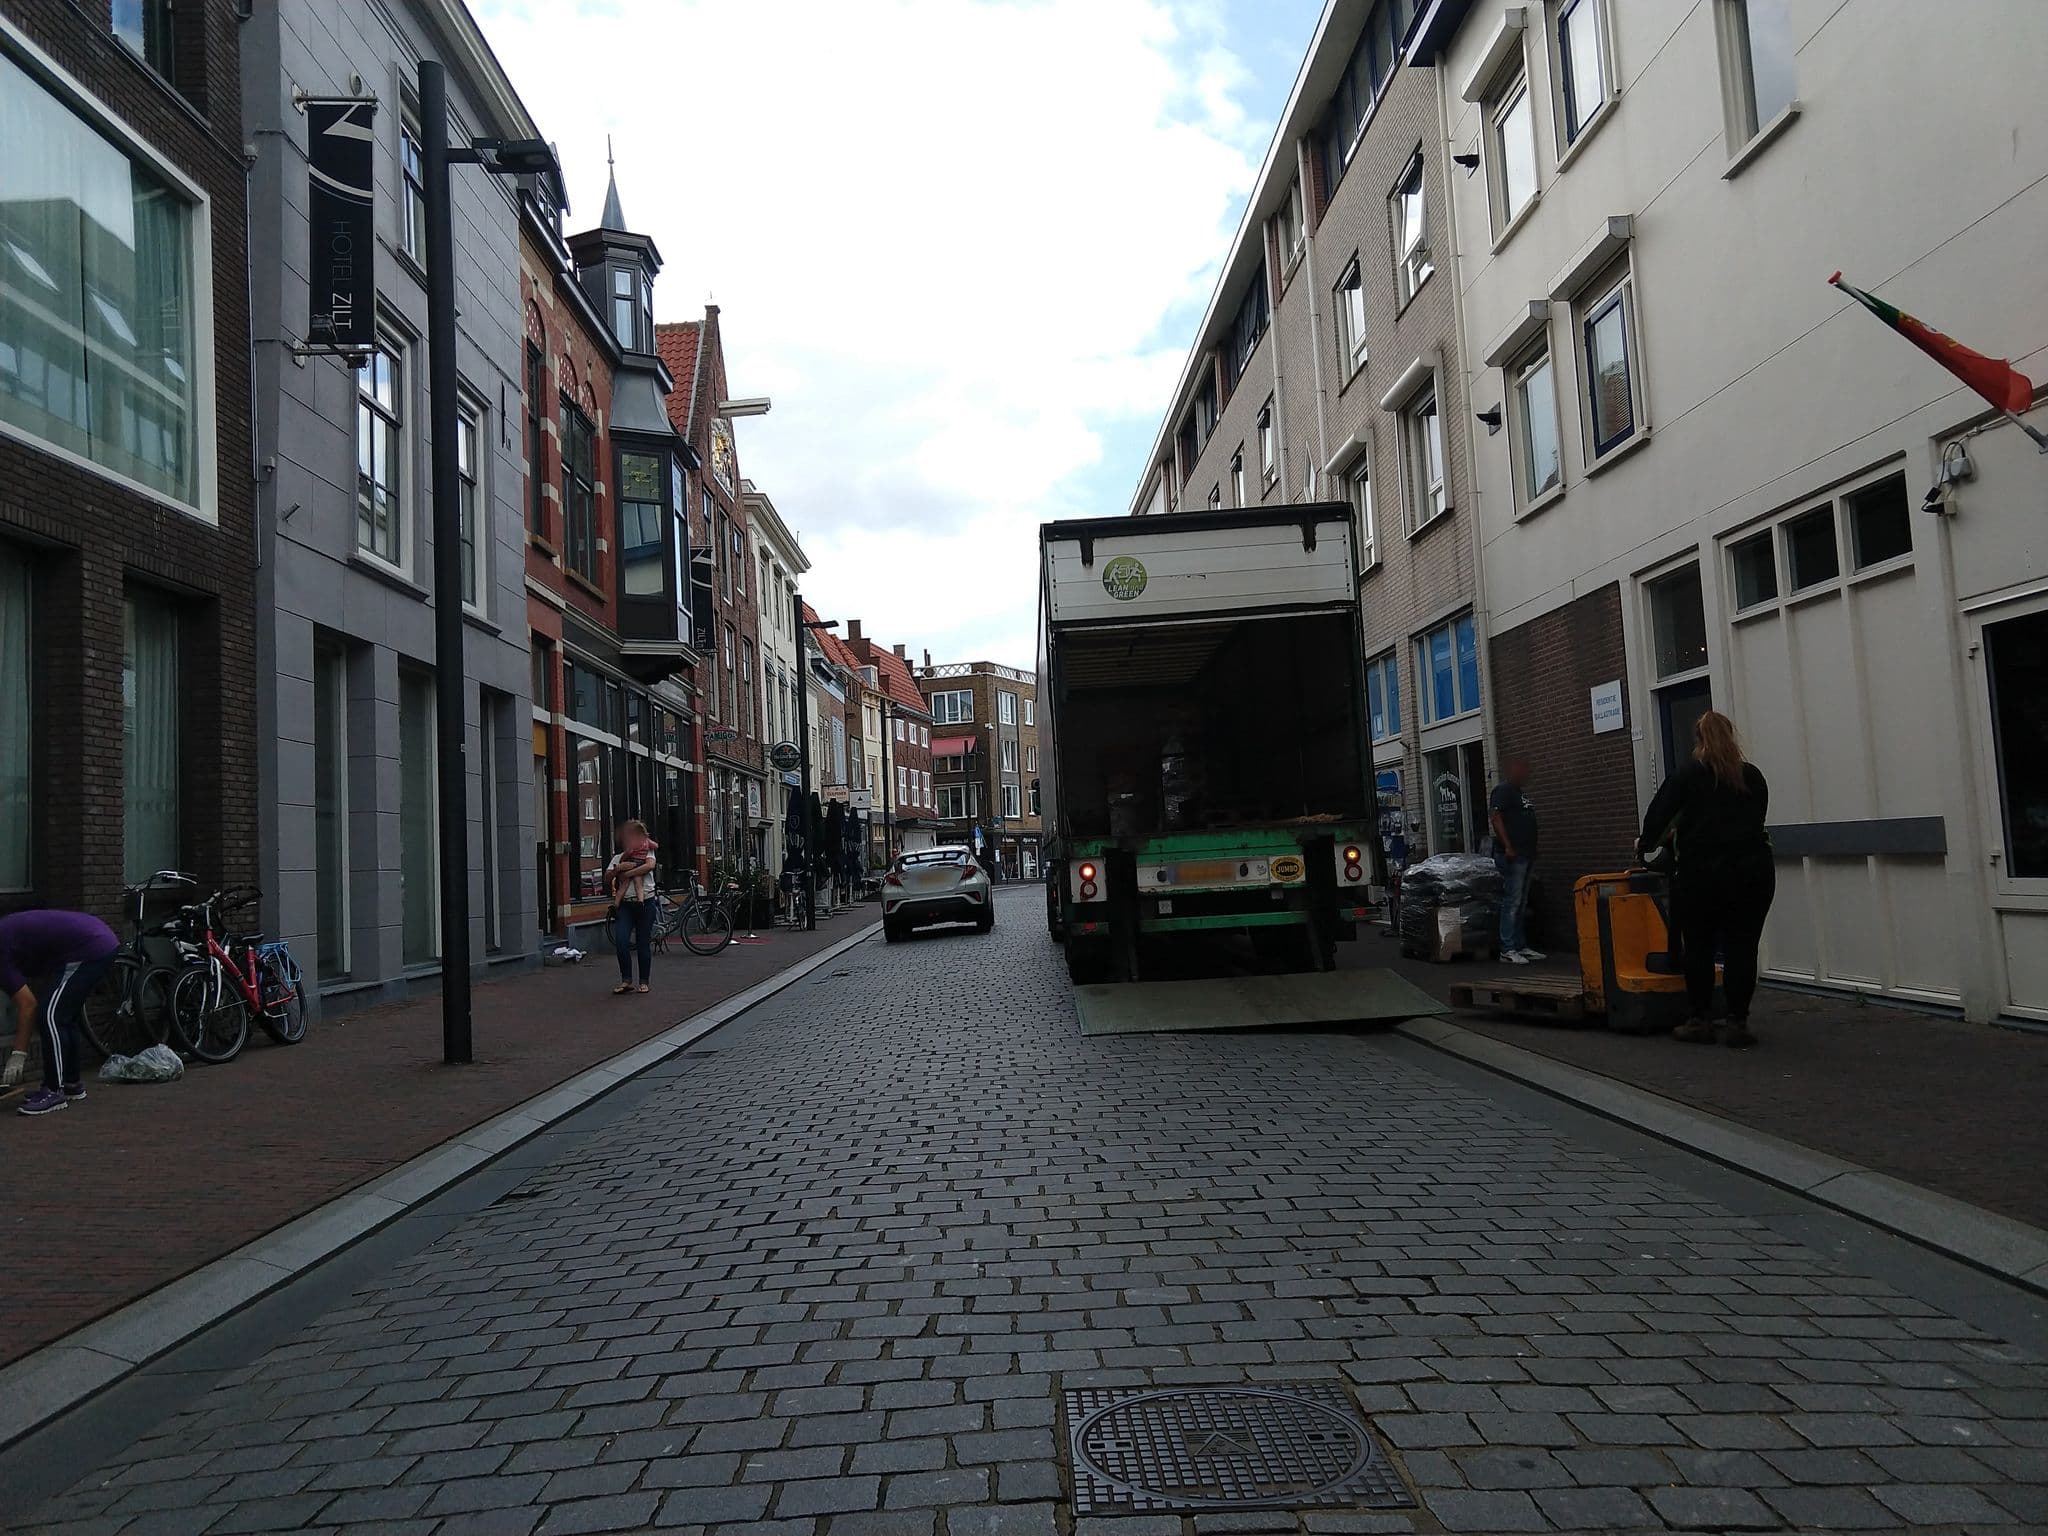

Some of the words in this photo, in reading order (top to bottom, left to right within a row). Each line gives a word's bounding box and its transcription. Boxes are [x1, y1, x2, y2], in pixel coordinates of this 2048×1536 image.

[331, 221, 352, 291] HOTEL
[332, 292, 353, 329] ZILT
[1108, 584, 1129, 592] LEAN
[1113, 590, 1139, 598] GREEN
[1276, 864, 1299, 873] JUMBO
